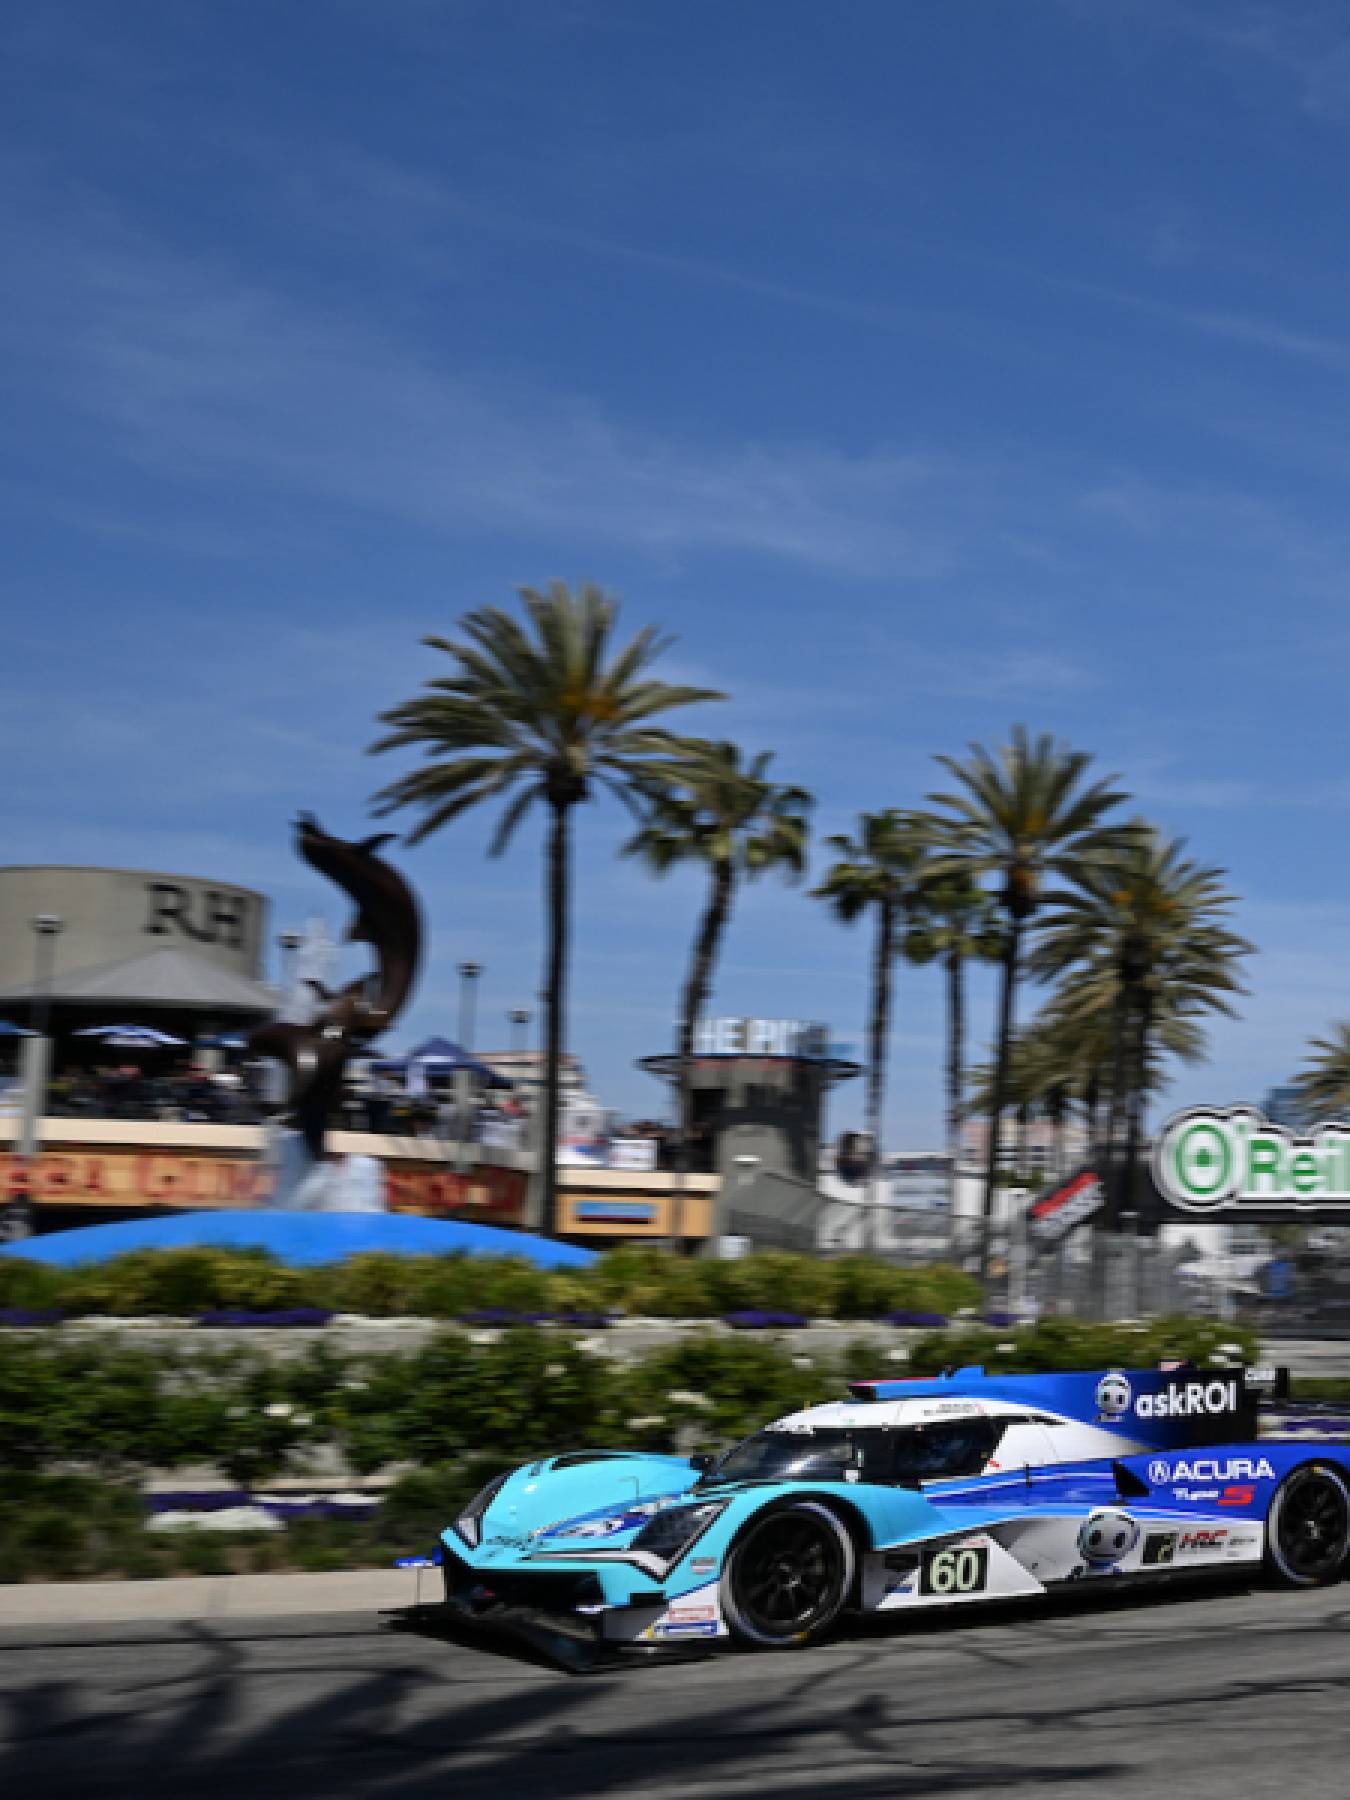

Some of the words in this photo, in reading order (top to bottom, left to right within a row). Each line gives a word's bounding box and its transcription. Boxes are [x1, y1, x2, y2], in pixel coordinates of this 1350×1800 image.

[143, 882, 247, 951] RH
[1134, 1382, 1237, 1418] askROI
[1173, 1458, 1275, 1480] ACURA
[1216, 1485, 1256, 1506] S
[930, 1550, 979, 1592] 60
